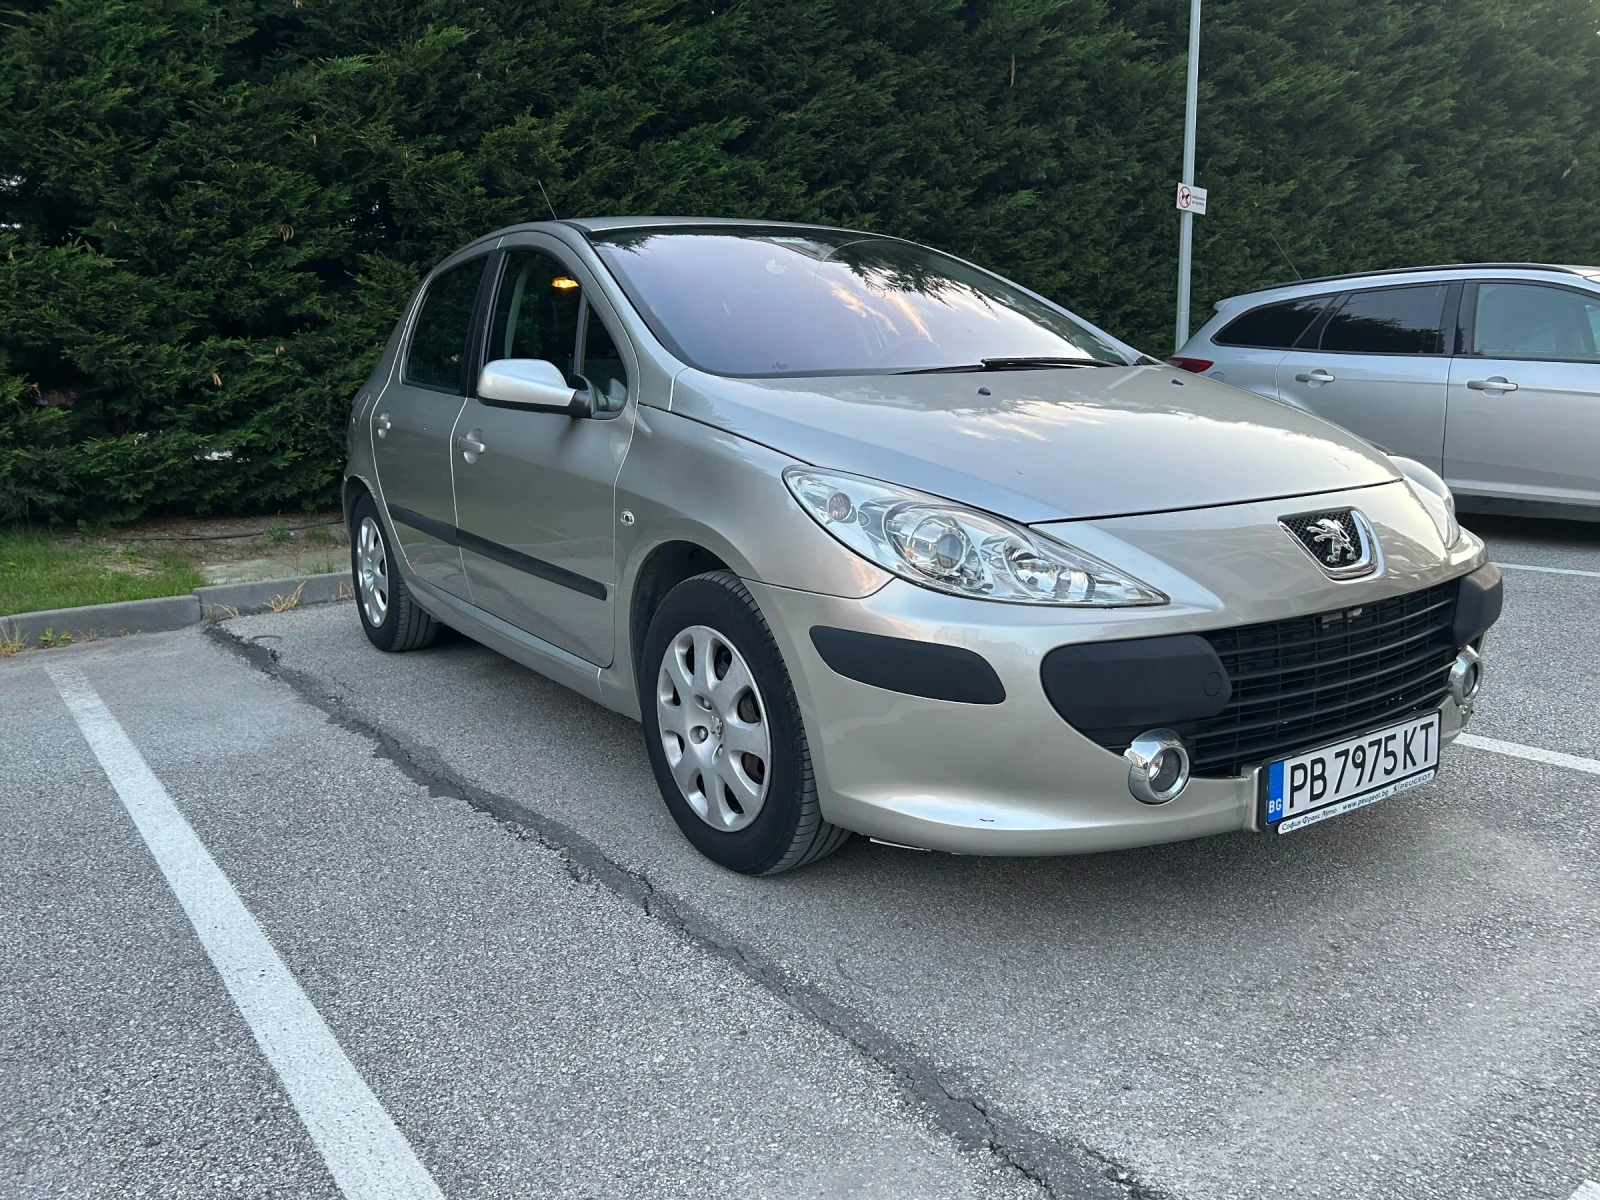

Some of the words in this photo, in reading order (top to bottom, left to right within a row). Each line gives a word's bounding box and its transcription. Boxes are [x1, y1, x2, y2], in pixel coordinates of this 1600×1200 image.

[1400, 772, 1432, 789] PEUGEOT
[1268, 798, 1282, 813] BG
[1342, 789, 1389, 811] www.peugeot.bg
